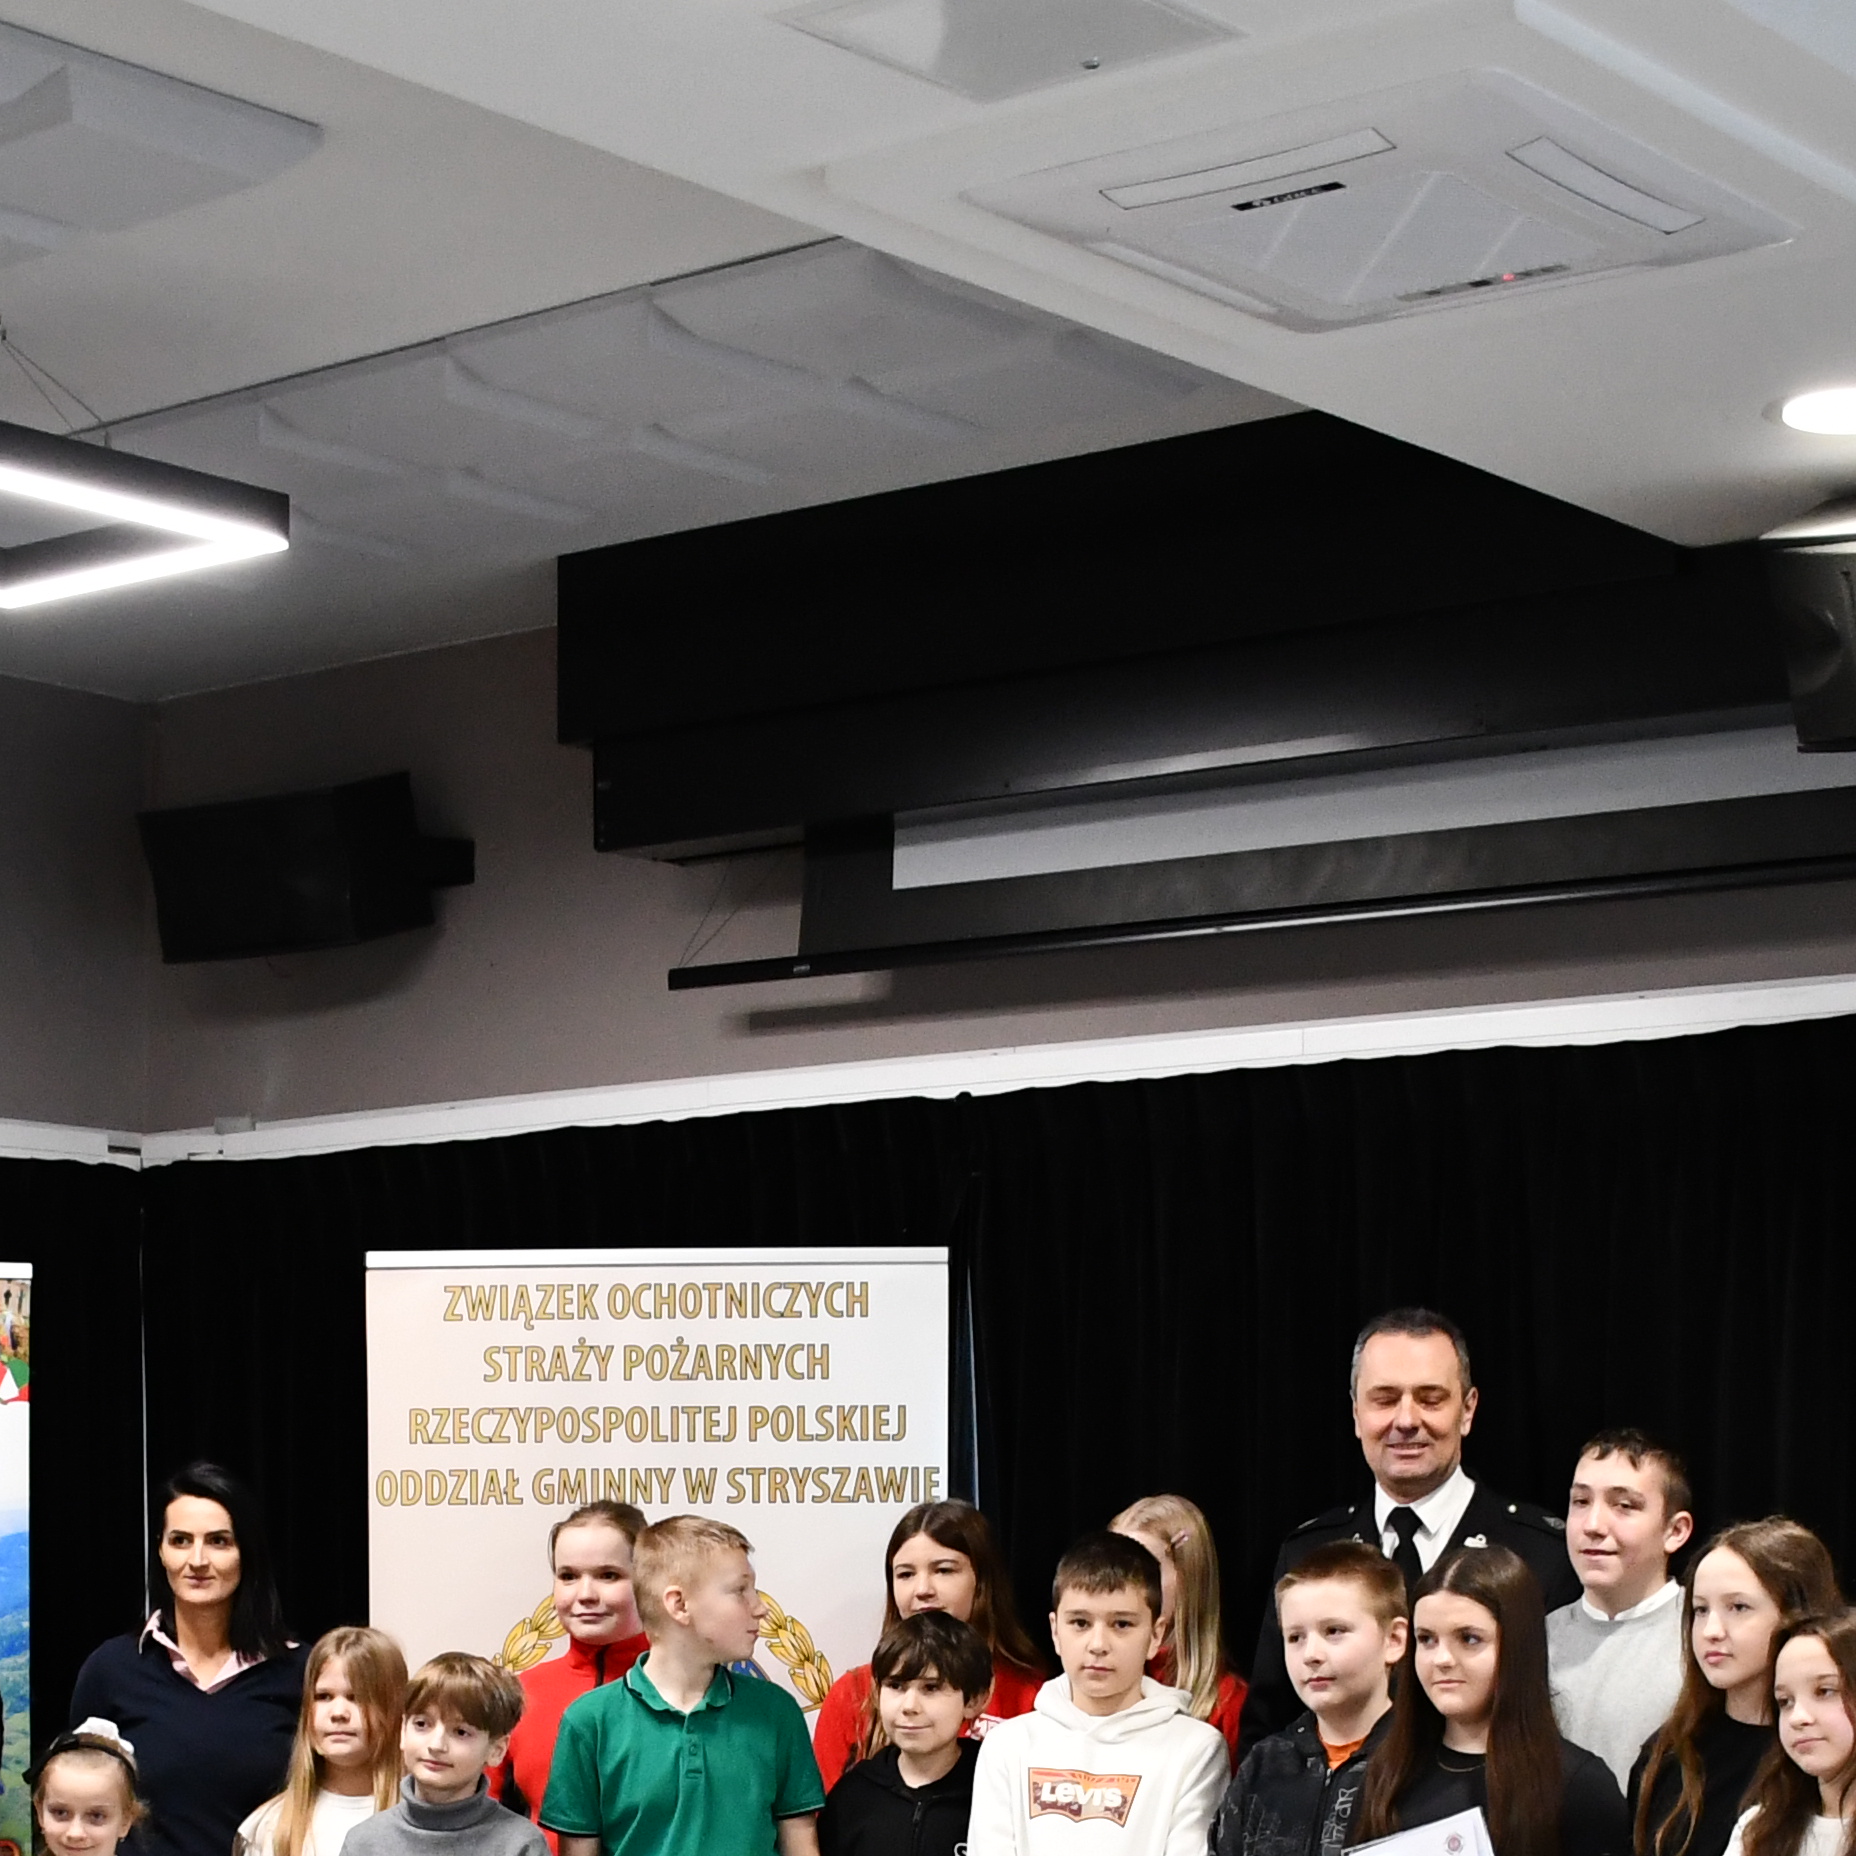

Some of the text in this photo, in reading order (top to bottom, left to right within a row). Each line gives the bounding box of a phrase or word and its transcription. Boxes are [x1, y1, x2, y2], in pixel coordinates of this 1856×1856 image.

[444, 1281, 869, 1330] ZWIĄZEK OCHOTNICZYCH
[483, 1336, 830, 1383] STRAŻY POŻARNYCH
[409, 1404, 907, 1444] RZECZYPOSPOLITEJ POLSKIEJ
[376, 1466, 941, 1506] ODDZIAŁ GMINNY W STRYSZAWIE
